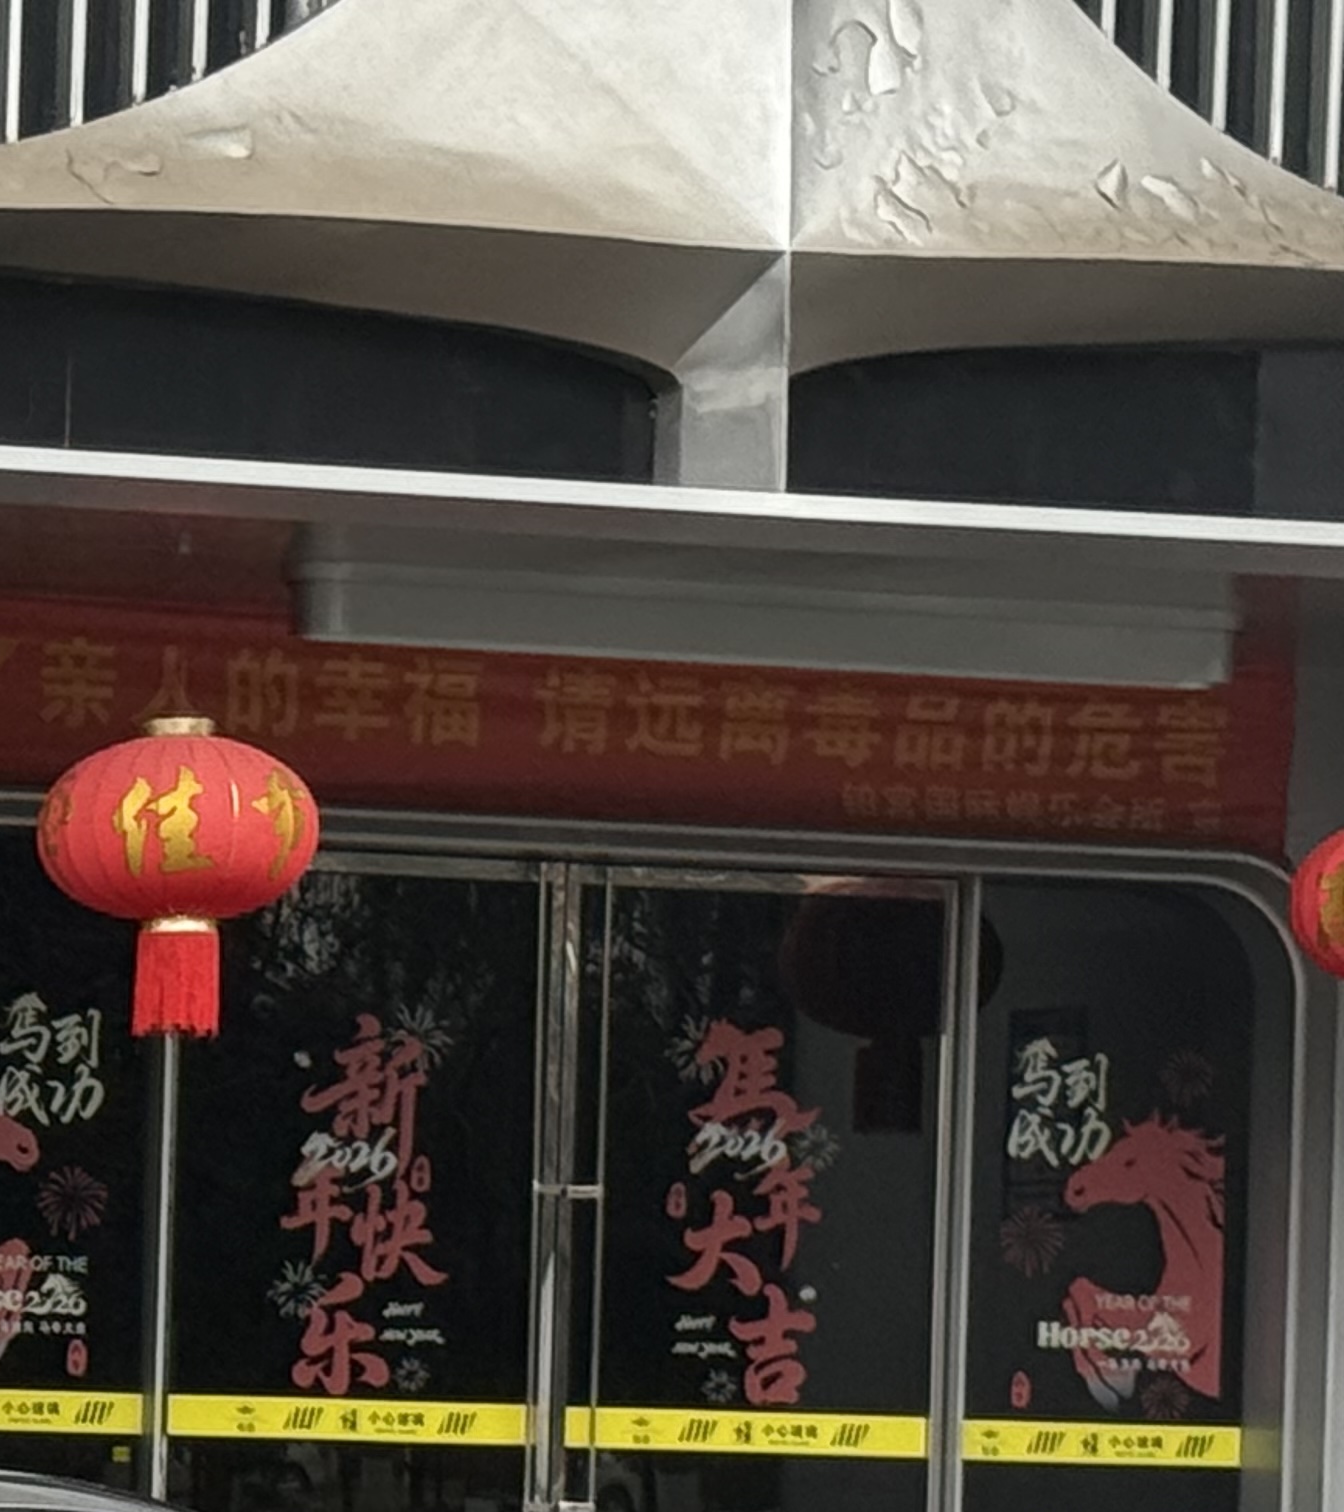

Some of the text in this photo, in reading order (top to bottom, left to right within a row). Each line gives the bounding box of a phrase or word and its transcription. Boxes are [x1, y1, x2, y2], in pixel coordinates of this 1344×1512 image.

[535, 667, 1228, 789] 请远离毒品的危害
[293, 1127, 397, 1192] 2026
[687, 1117, 787, 1179] 2026
[30, 1254, 53, 1271] OF
[56, 1255, 88, 1274] THE
[1095, 1294, 1191, 1312] YEAR OF THE
